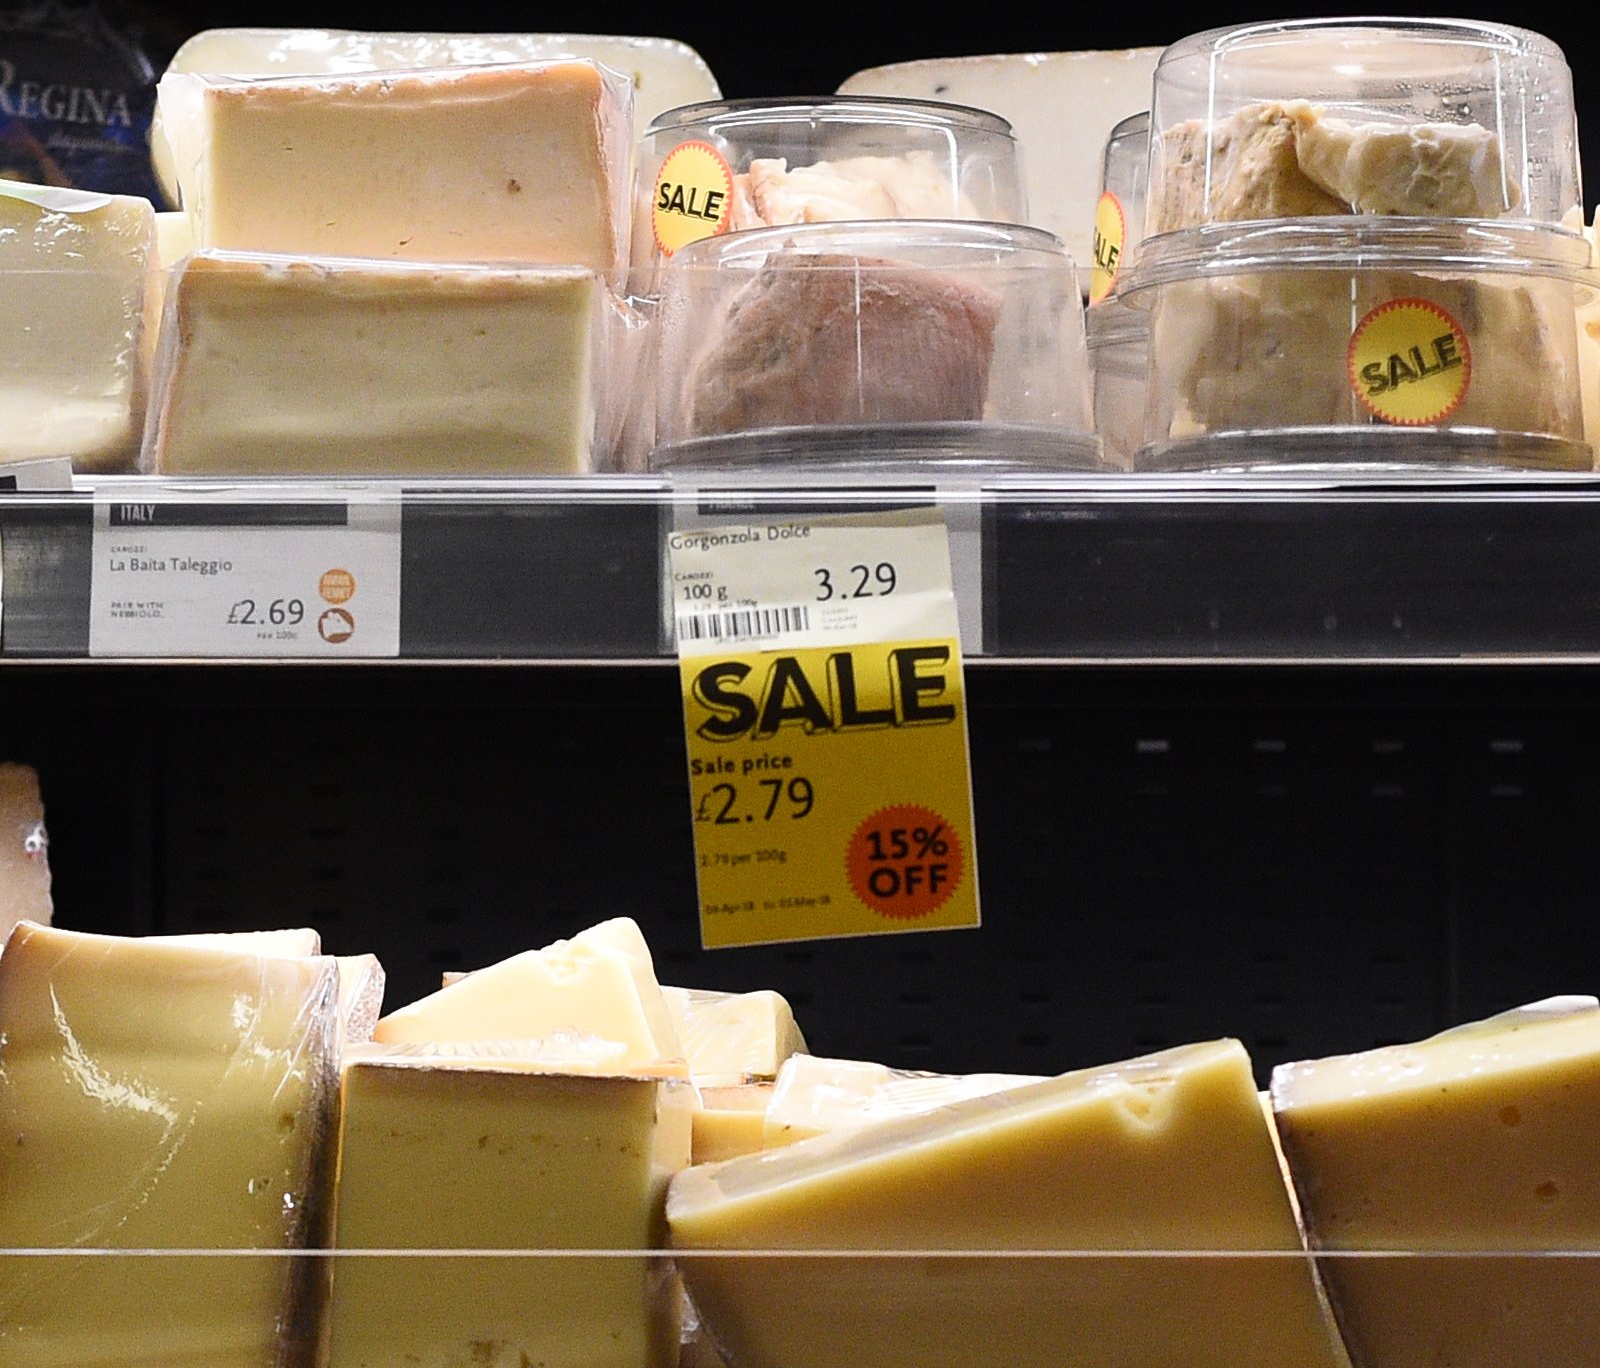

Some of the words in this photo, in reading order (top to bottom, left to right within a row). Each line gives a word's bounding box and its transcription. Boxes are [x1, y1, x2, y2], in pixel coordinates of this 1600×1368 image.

[656, 178, 725, 224] SALE
[1359, 332, 1462, 397] SALE
[109, 560, 126, 572] La
[129, 559, 166, 572] Baita
[170, 559, 233, 575] Taleggio
[814, 562, 898, 602] 3.29
[227, 599, 305, 626] £2.69
[692, 645, 956, 743] SALE
[690, 757, 736, 776] Sale
[742, 753, 793, 777] price
[694, 777, 815, 826] £2.79
[866, 825, 949, 863] 15%
